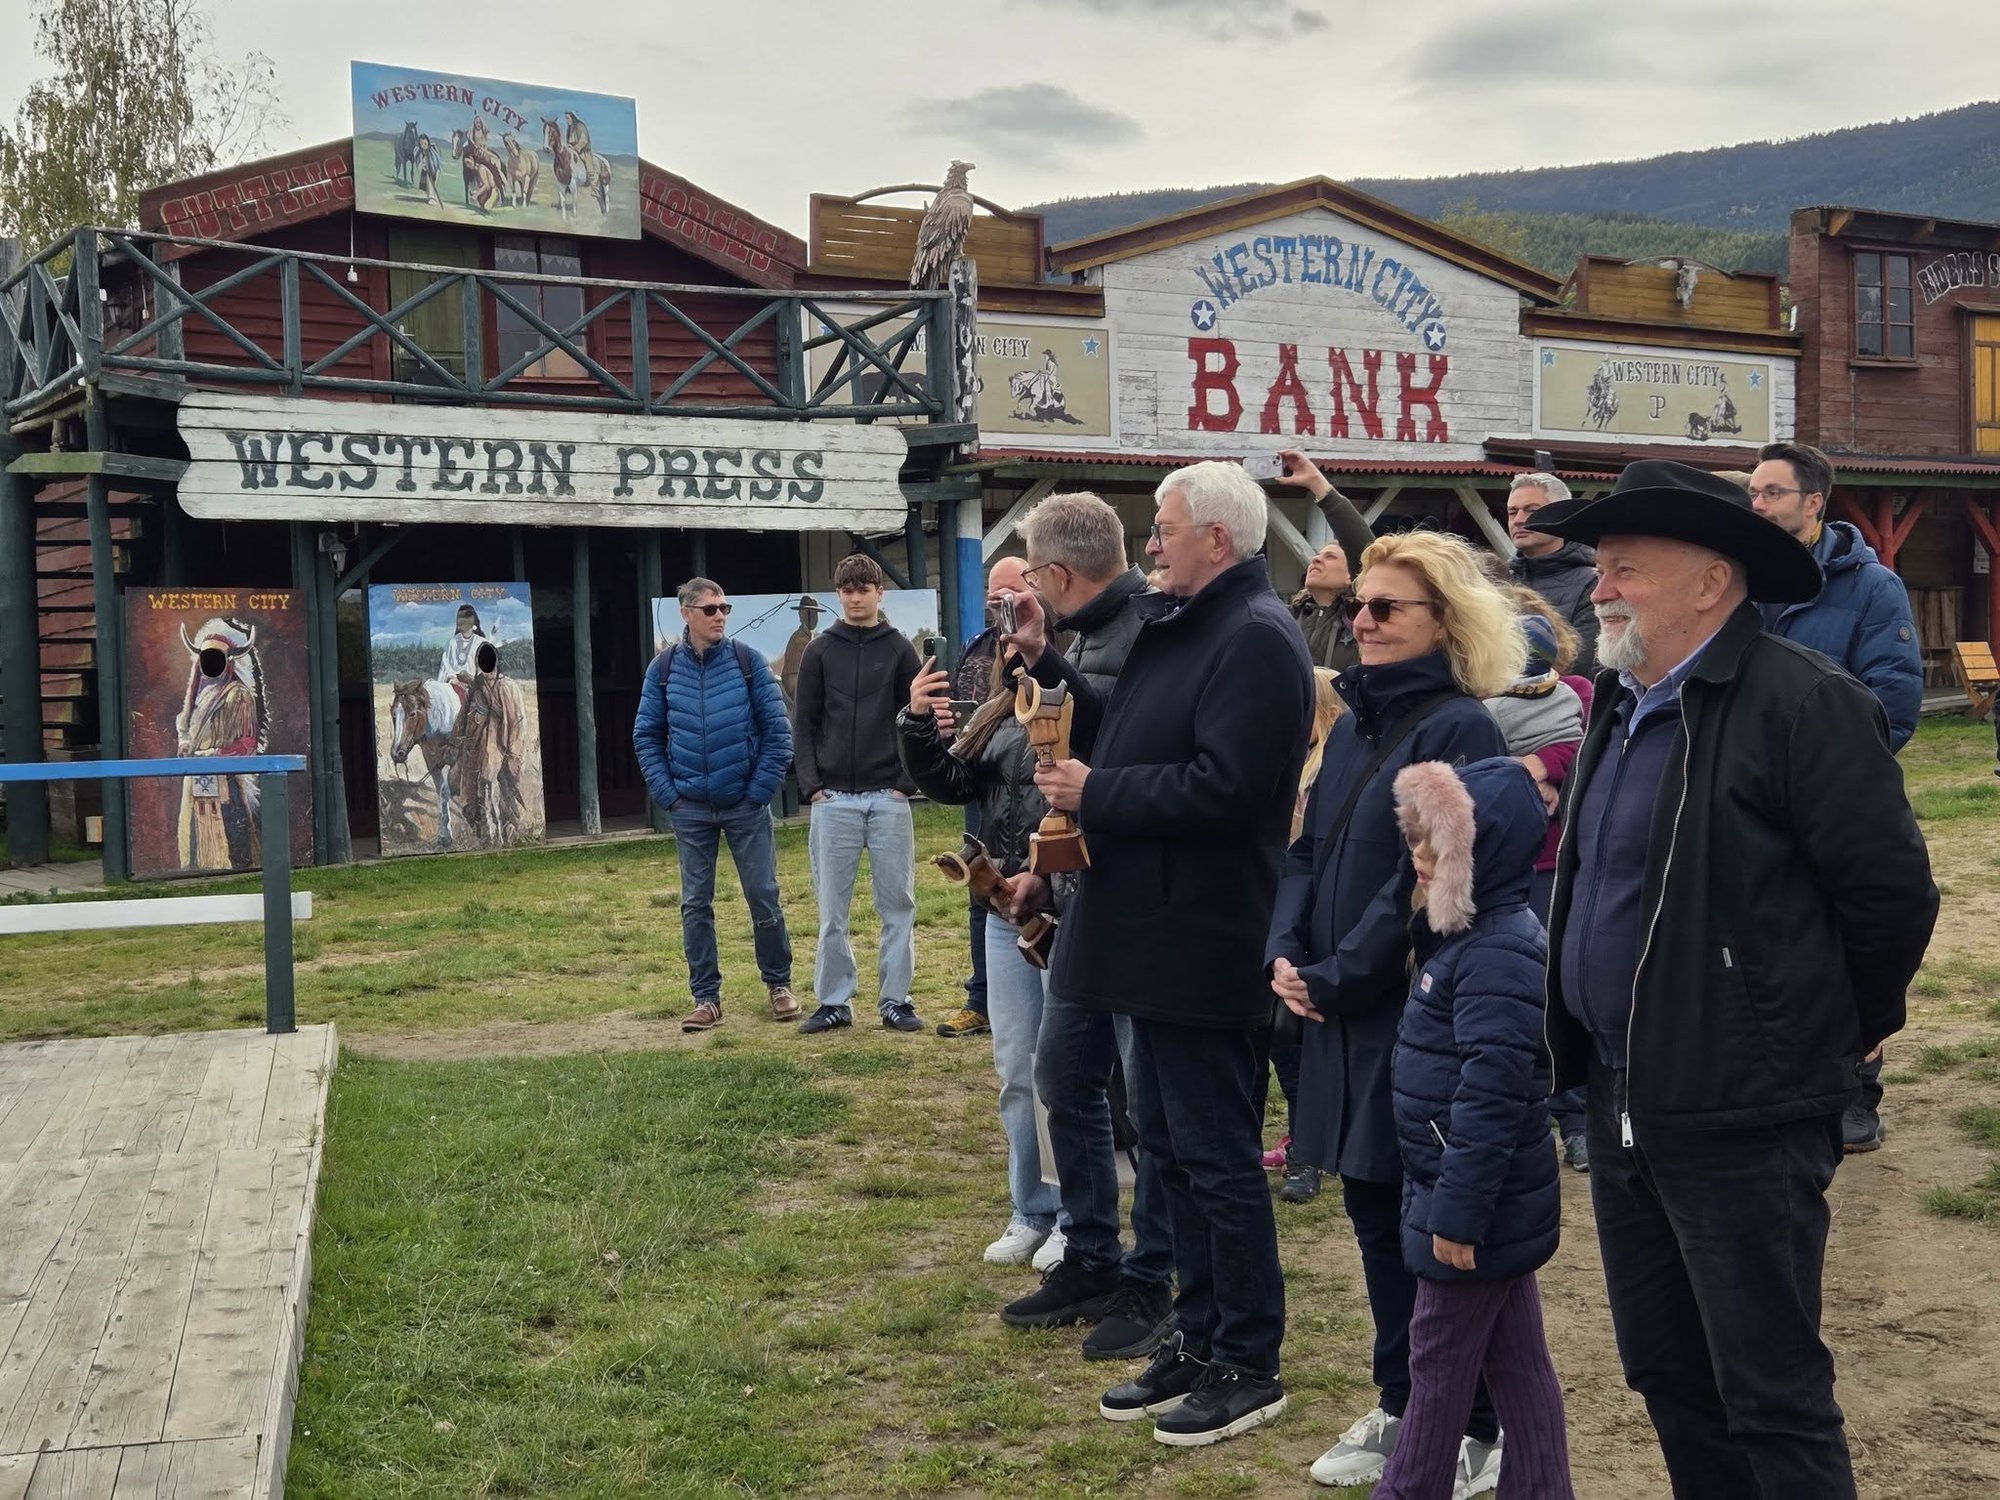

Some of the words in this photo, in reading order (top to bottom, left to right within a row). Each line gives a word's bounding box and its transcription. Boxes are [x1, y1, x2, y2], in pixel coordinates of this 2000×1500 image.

[370, 82, 475, 110] WESTERN
[482, 96, 528, 132] CITY
[160, 154, 354, 247] CUTTING
[1194, 234, 1376, 311] WESTERN
[1371, 257, 1443, 333] CITY
[993, 337, 1030, 357] CITY
[1187, 336, 1449, 444] BANK
[1612, 361, 1681, 385] WESTERN
[1686, 364, 1720, 387] CITY
[226, 431, 577, 496] WESTERN
[612, 446, 825, 504] PRESS
[148, 593, 237, 610] WESTERN
[248, 594, 290, 610] CITY
[393, 587, 461, 602] WESTERN
[470, 587, 506, 600] CITY
